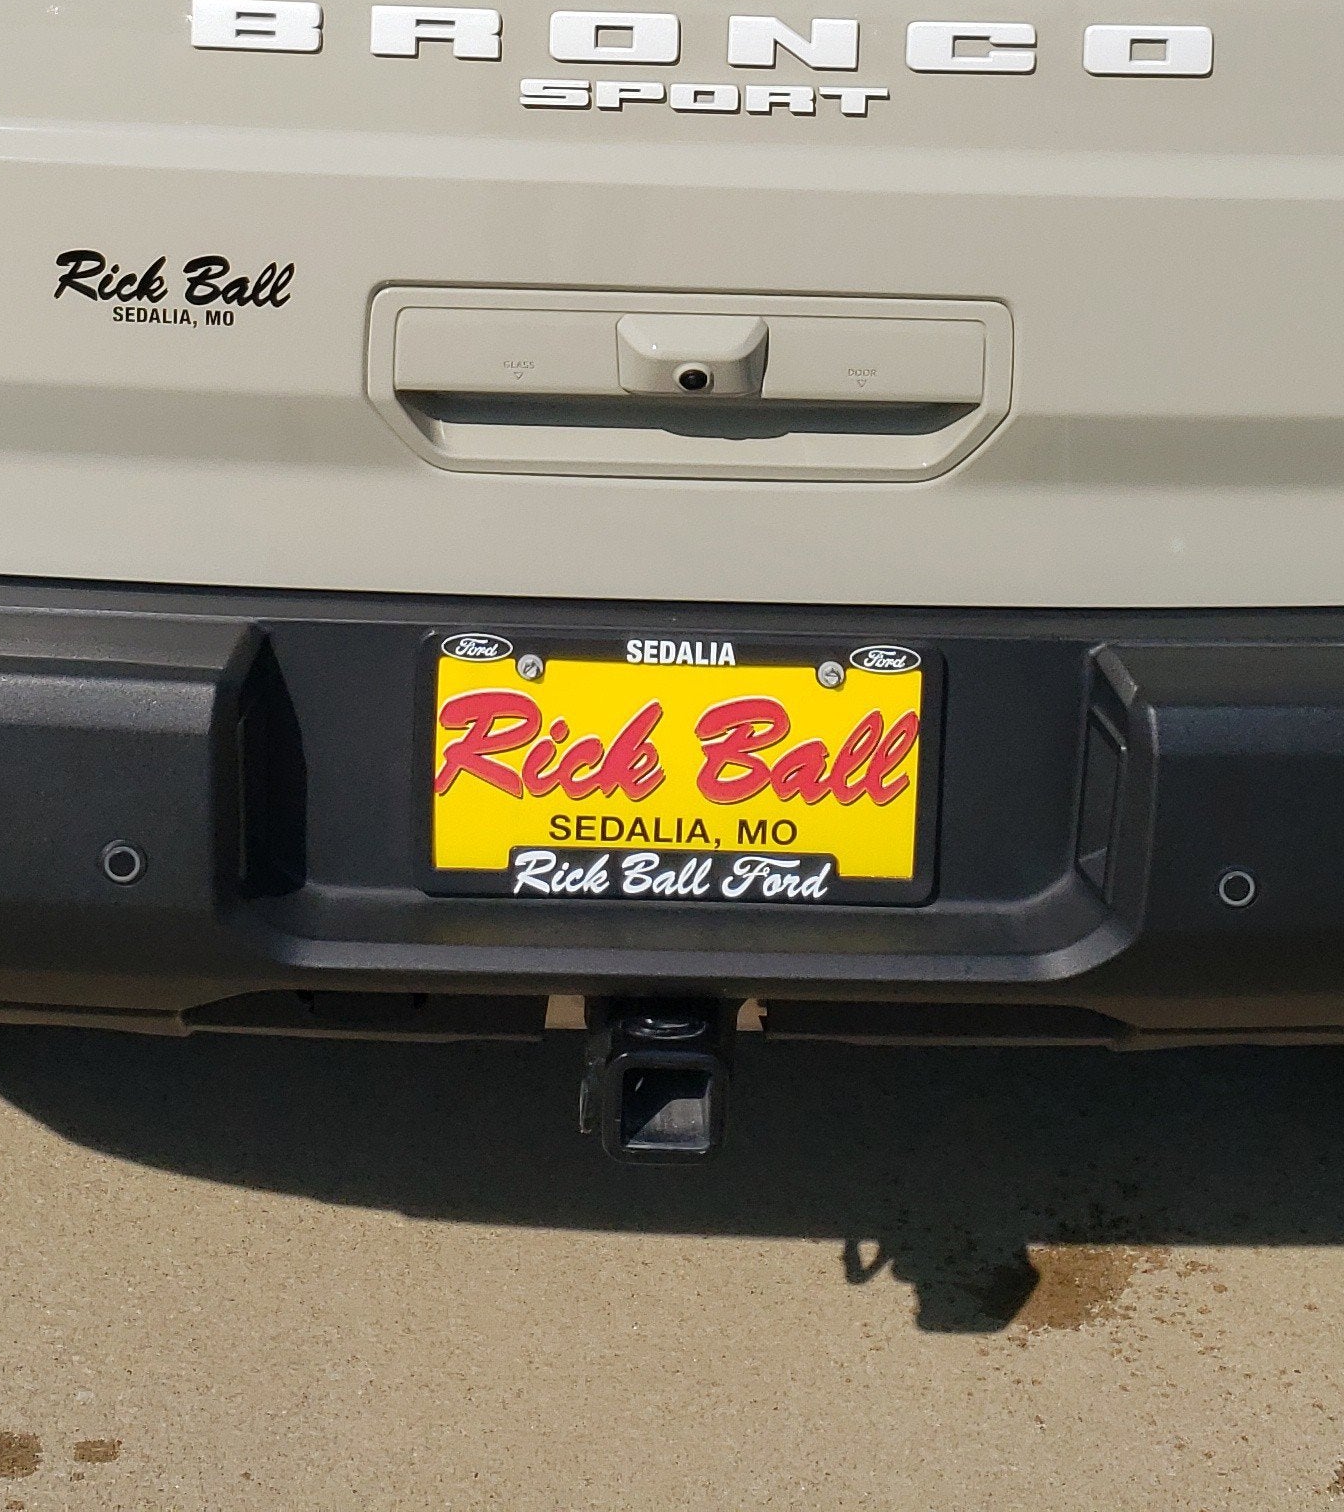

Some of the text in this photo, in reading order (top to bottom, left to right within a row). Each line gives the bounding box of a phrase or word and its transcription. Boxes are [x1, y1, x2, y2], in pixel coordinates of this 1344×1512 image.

[519, 78, 889, 117] SPORT
[54, 249, 296, 309] Rick Ball
[112, 305, 236, 329] SEDALIA, MO
[455, 638, 499, 657] Ford
[626, 639, 736, 667] SEDALIA
[863, 649, 907, 668] Ford
[435, 688, 921, 807] Rick Ball
[548, 814, 798, 850] SEDALIA, MO
[513, 850, 830, 900] Rick Ball Ford
